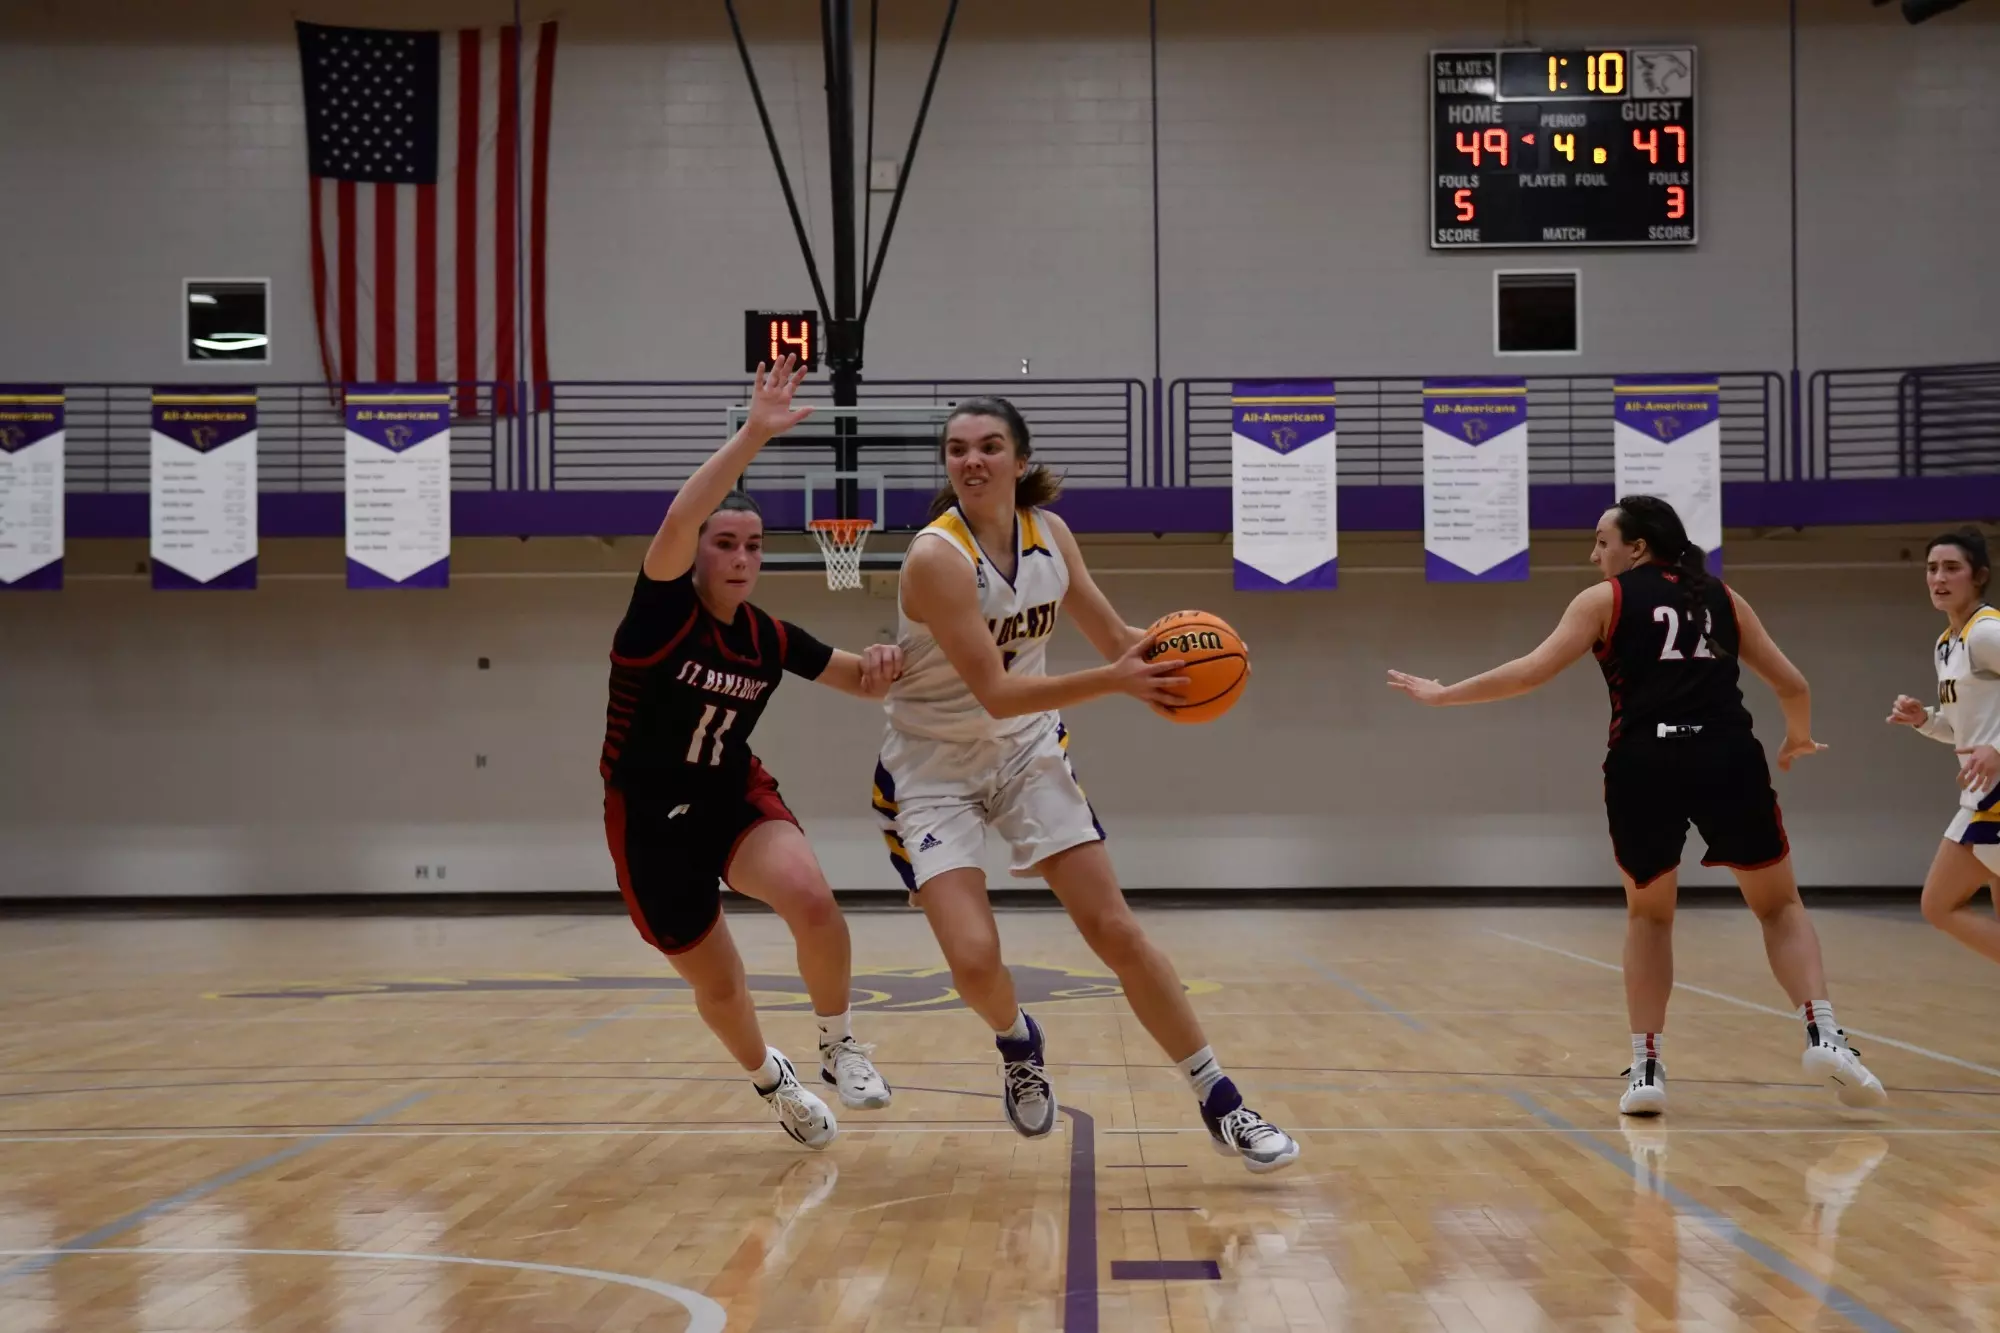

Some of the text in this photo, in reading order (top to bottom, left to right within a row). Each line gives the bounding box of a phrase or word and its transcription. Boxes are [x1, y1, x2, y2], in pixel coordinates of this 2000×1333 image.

[1437, 77, 1495, 94] WILDC
[1448, 105, 1504, 124] HOME
[1621, 101, 1683, 121] GUEST
[1540, 113, 1587, 127] PERIOD
[1455, 128, 1509, 167] 49
[1553, 133, 1575, 162] 4
[1632, 125, 1686, 164] 47
[1438, 174, 1480, 188] FOULS
[1519, 173, 1609, 187] PLAYER FOUL
[1648, 172, 1690, 185] FOULS
[1666, 186, 1685, 219] 3
[1438, 228, 1481, 242] SCORE
[1542, 227, 1587, 240] MATCH
[1648, 226, 1691, 240] SCORE
[772, 321, 809, 361] 14
[1432, 403, 1517, 414] All-Americans
[1624, 401, 1709, 412] All-Americans
[162, 410, 248, 422] All-Americans
[355, 410, 440, 421] All-Americans
[1241, 411, 1326, 423] All-Americans
[675, 659, 769, 701] ST. BENEDICT
[685, 703, 738, 767] 11
